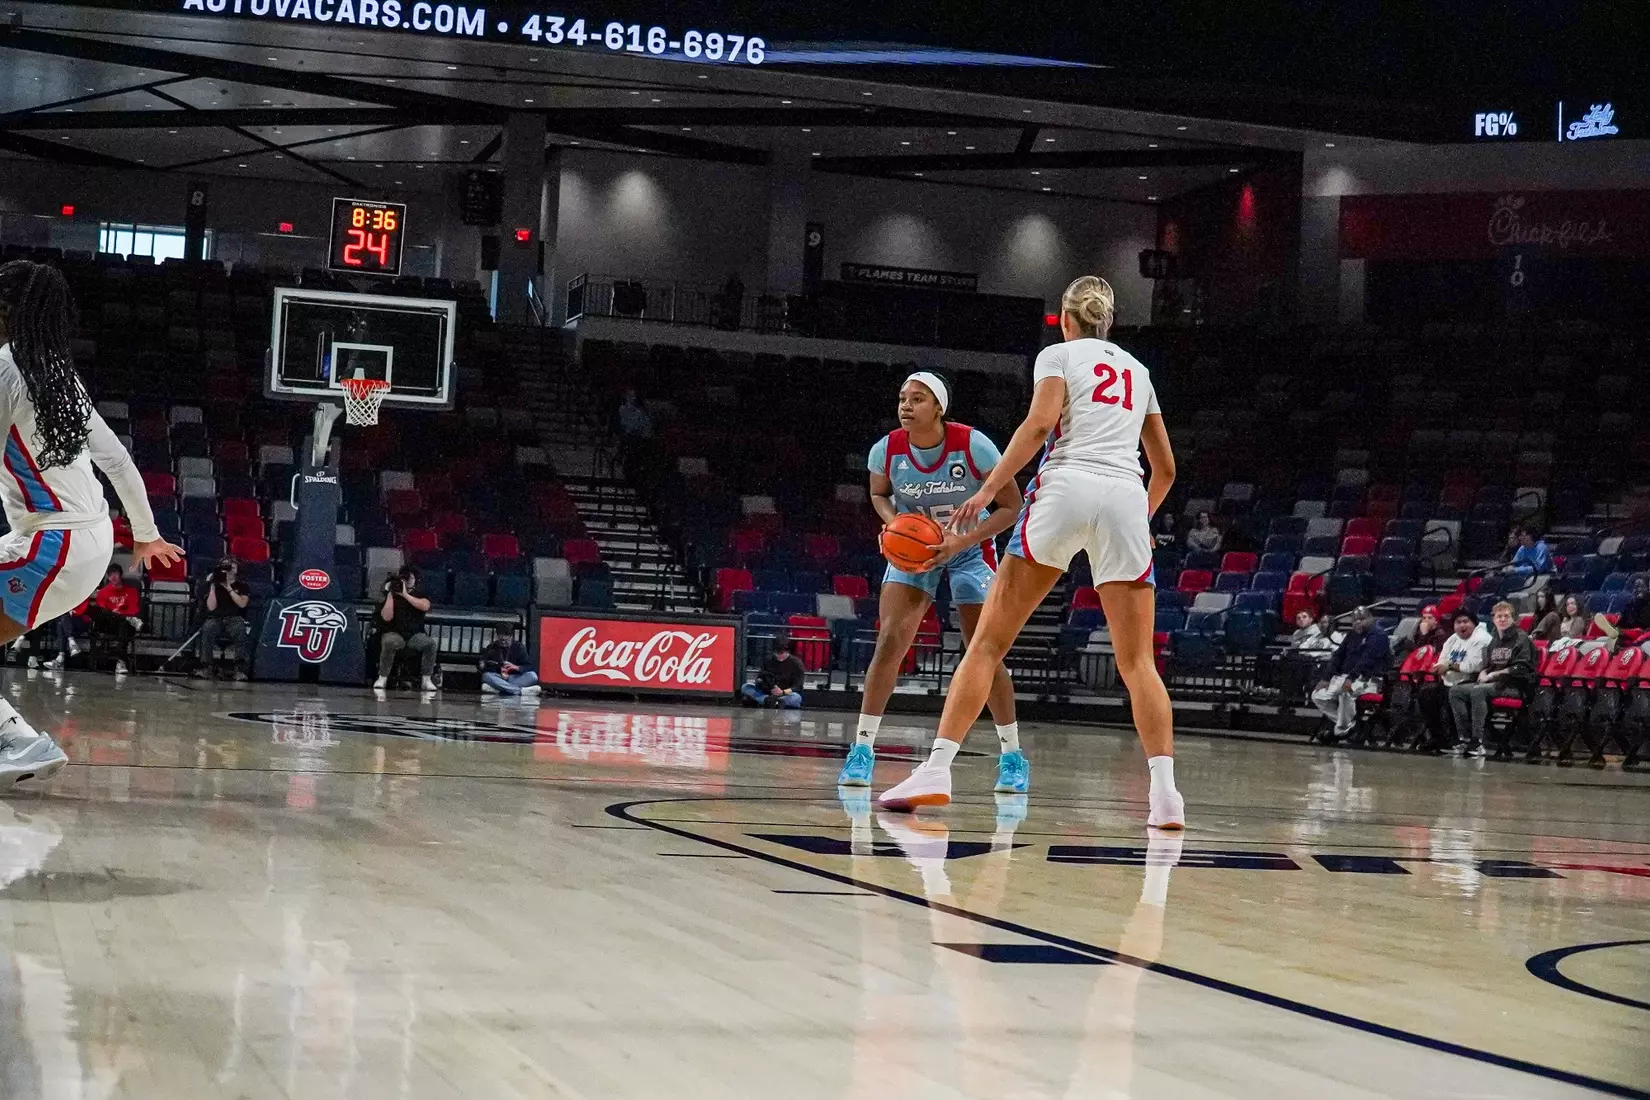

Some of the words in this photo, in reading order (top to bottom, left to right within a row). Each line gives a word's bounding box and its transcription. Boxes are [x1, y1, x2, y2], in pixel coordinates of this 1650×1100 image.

[521, 14, 766, 65] 434-616-6976
[1475, 112, 1518, 136] FG%
[191, 190, 204, 206] 8
[352, 207, 396, 230] 8:36
[344, 229, 387, 265] 24
[808, 231, 821, 247] 9
[857, 268, 903, 281] FLAMES
[906, 272, 938, 284] TEAM
[1092, 363, 1133, 411] 21
[304, 475, 337, 484] SPALDING
[900, 482, 923, 499] Lady
[560, 626, 718, 684] Coca-Cola
